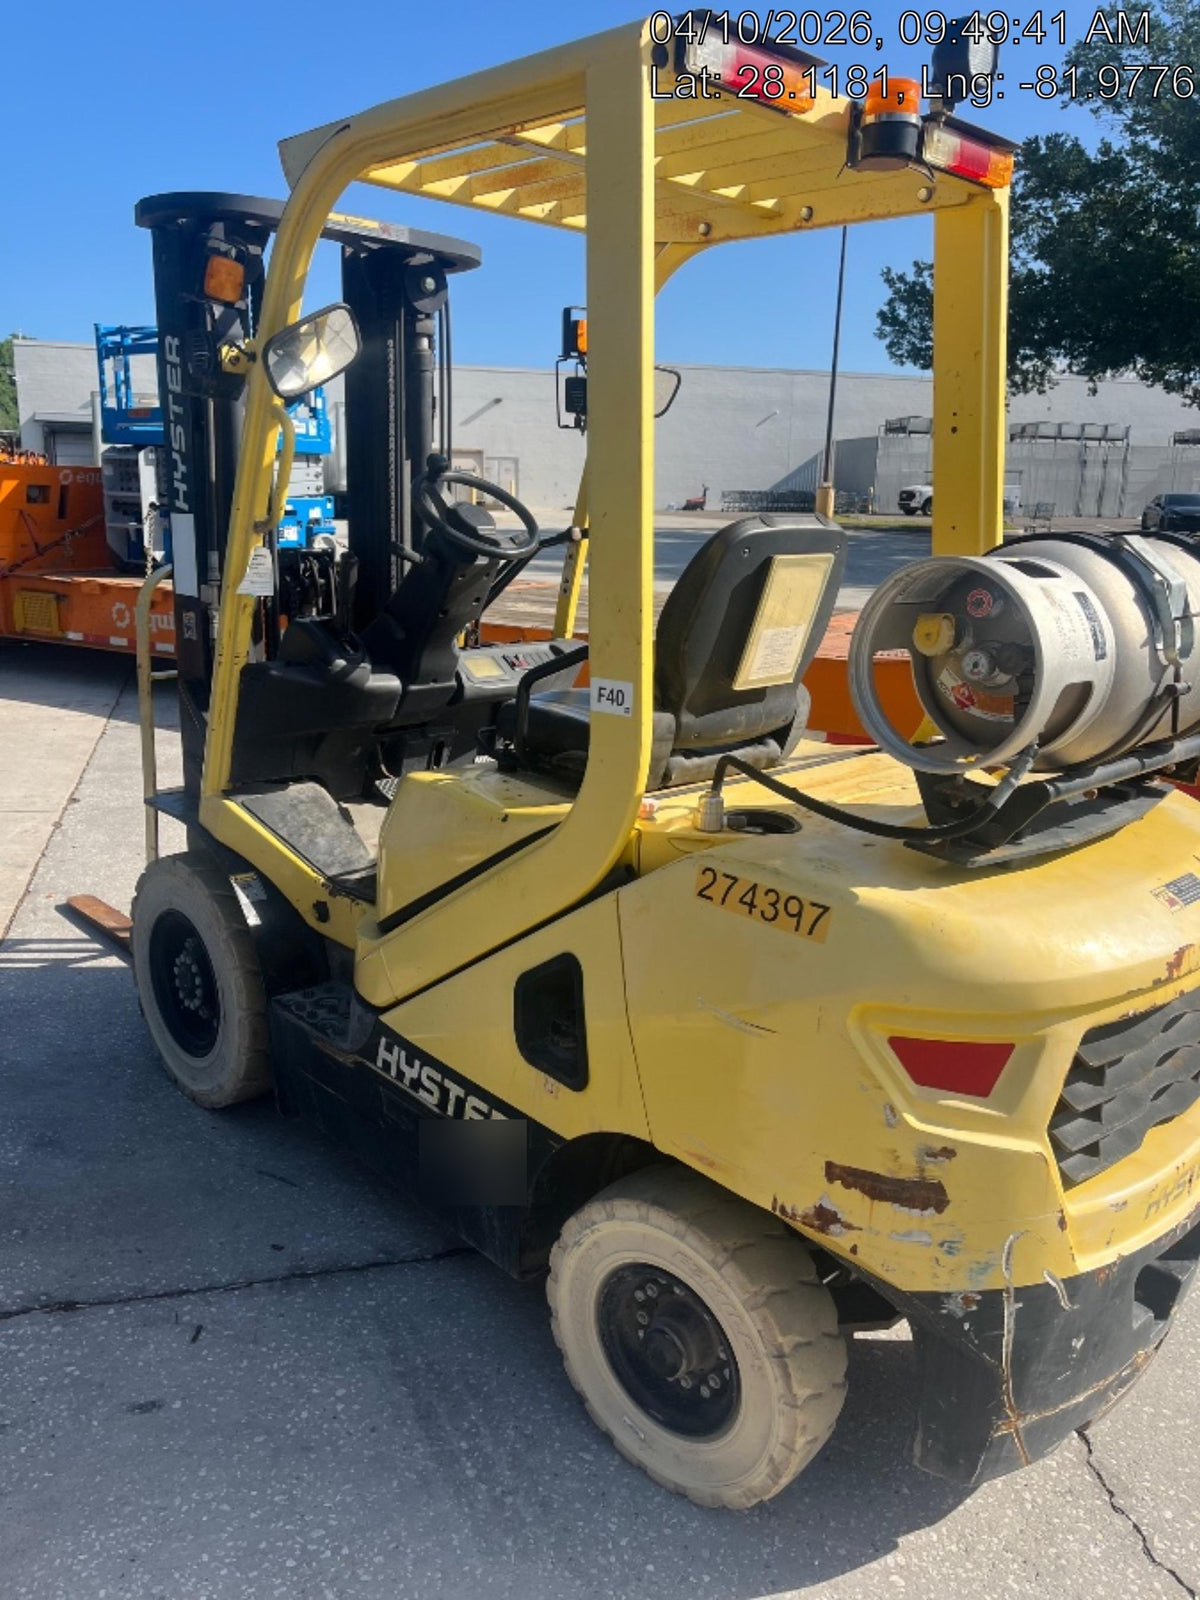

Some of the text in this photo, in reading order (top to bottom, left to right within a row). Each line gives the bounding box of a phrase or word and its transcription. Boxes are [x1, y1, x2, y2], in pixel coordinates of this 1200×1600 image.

[165, 335, 189, 511] HYSTER
[597, 686, 625, 706] F40
[697, 867, 831, 935] 274397
[376, 1036, 510, 1120] HYSTE
